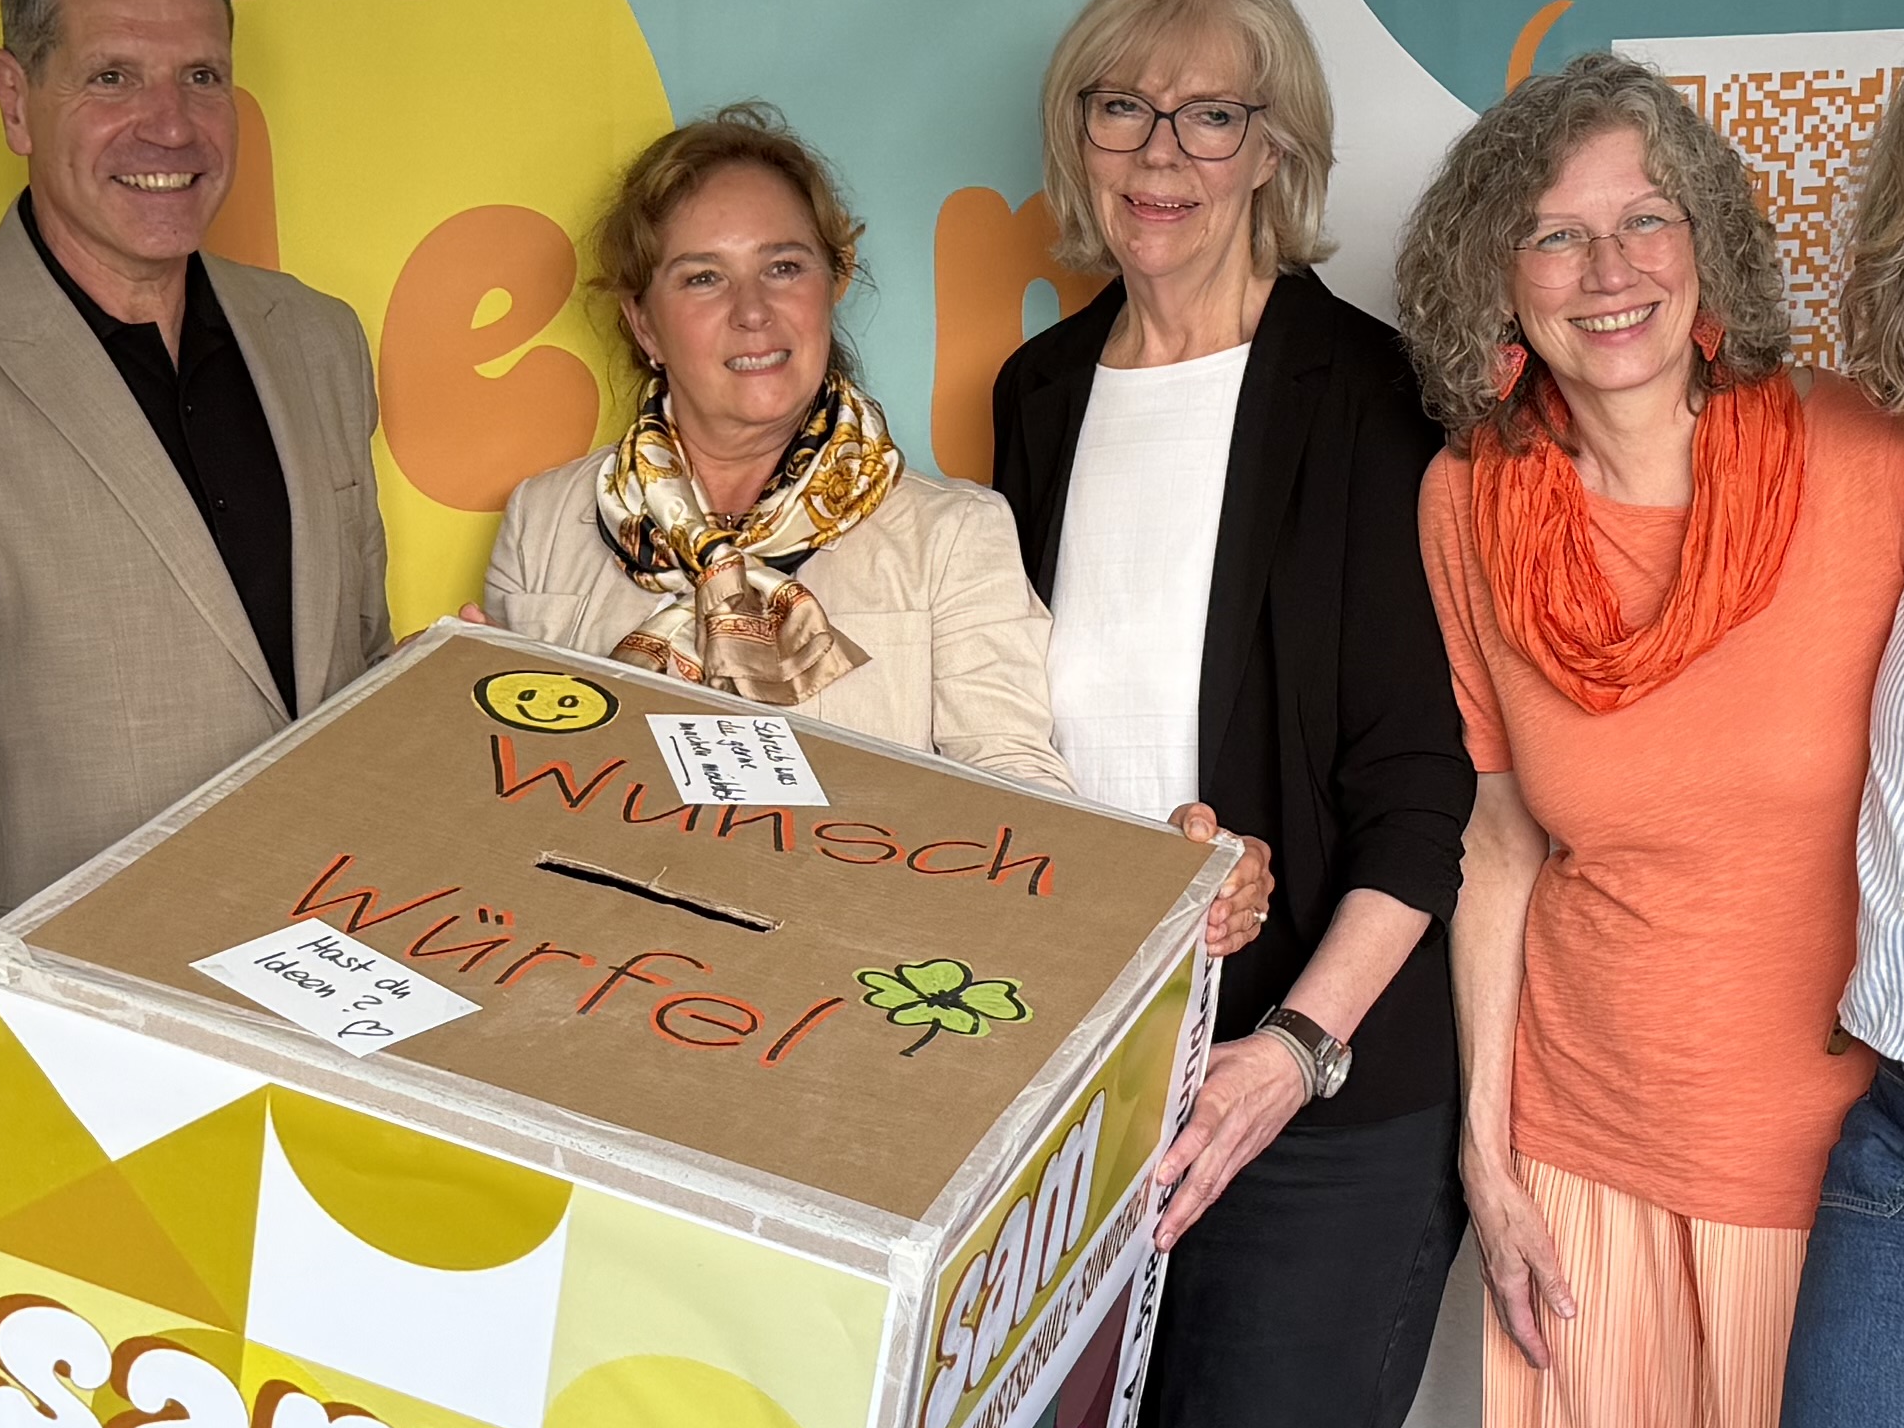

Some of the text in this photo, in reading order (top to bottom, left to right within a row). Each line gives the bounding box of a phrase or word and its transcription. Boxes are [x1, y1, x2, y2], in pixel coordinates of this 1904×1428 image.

[677, 722, 713, 757] machen
[715, 739, 758, 770] gerne
[752, 719, 796, 763] Schreib
[490, 733, 1054, 897] Wunsch
[253, 950, 337, 999] Ideen
[289, 852, 847, 1068] Würfel
[296, 934, 412, 1000] Hast du
